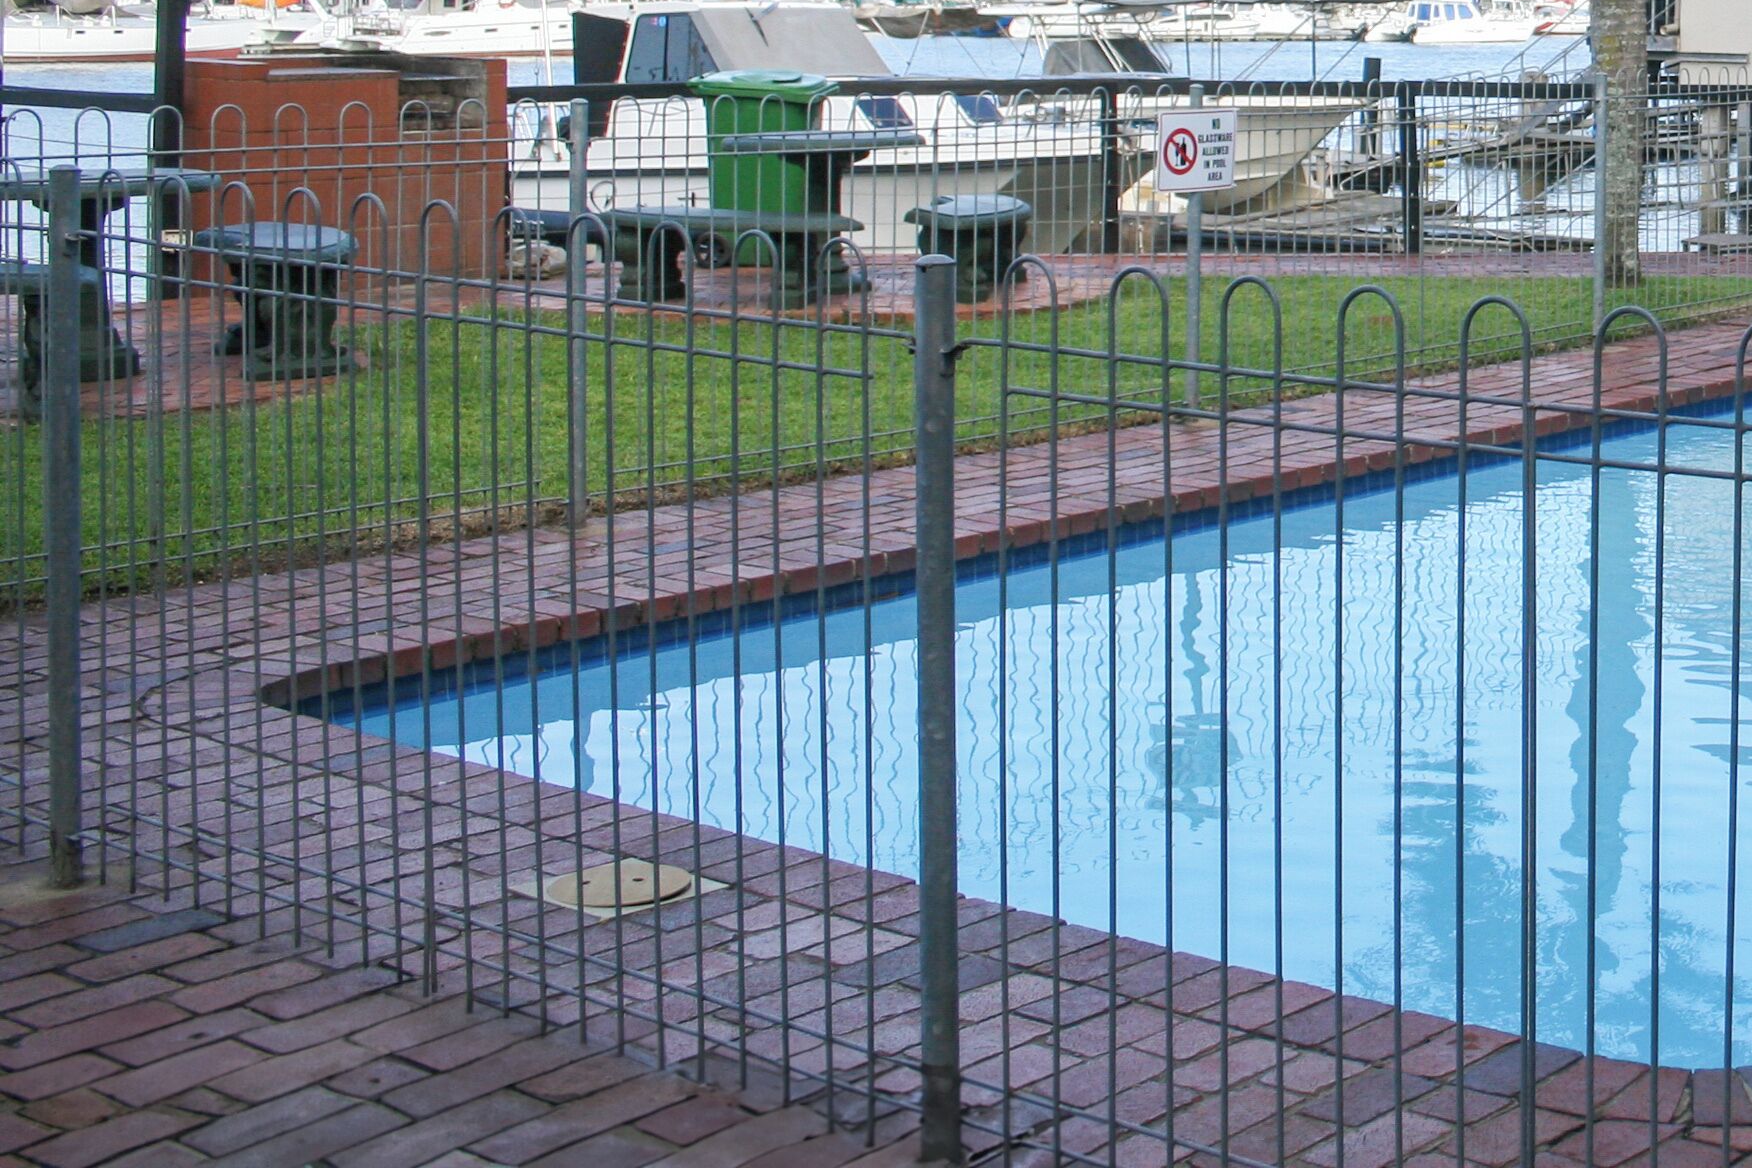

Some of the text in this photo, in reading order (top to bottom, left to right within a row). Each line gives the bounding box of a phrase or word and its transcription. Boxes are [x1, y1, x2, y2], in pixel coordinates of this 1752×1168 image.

[1212, 118, 1220, 130] NO
[1197, 132, 1233, 144] GLASSWARE
[1202, 145, 1229, 156] ALLOWED
[1203, 159, 1226, 169] IN POOL
[1207, 171, 1223, 181] AREA
